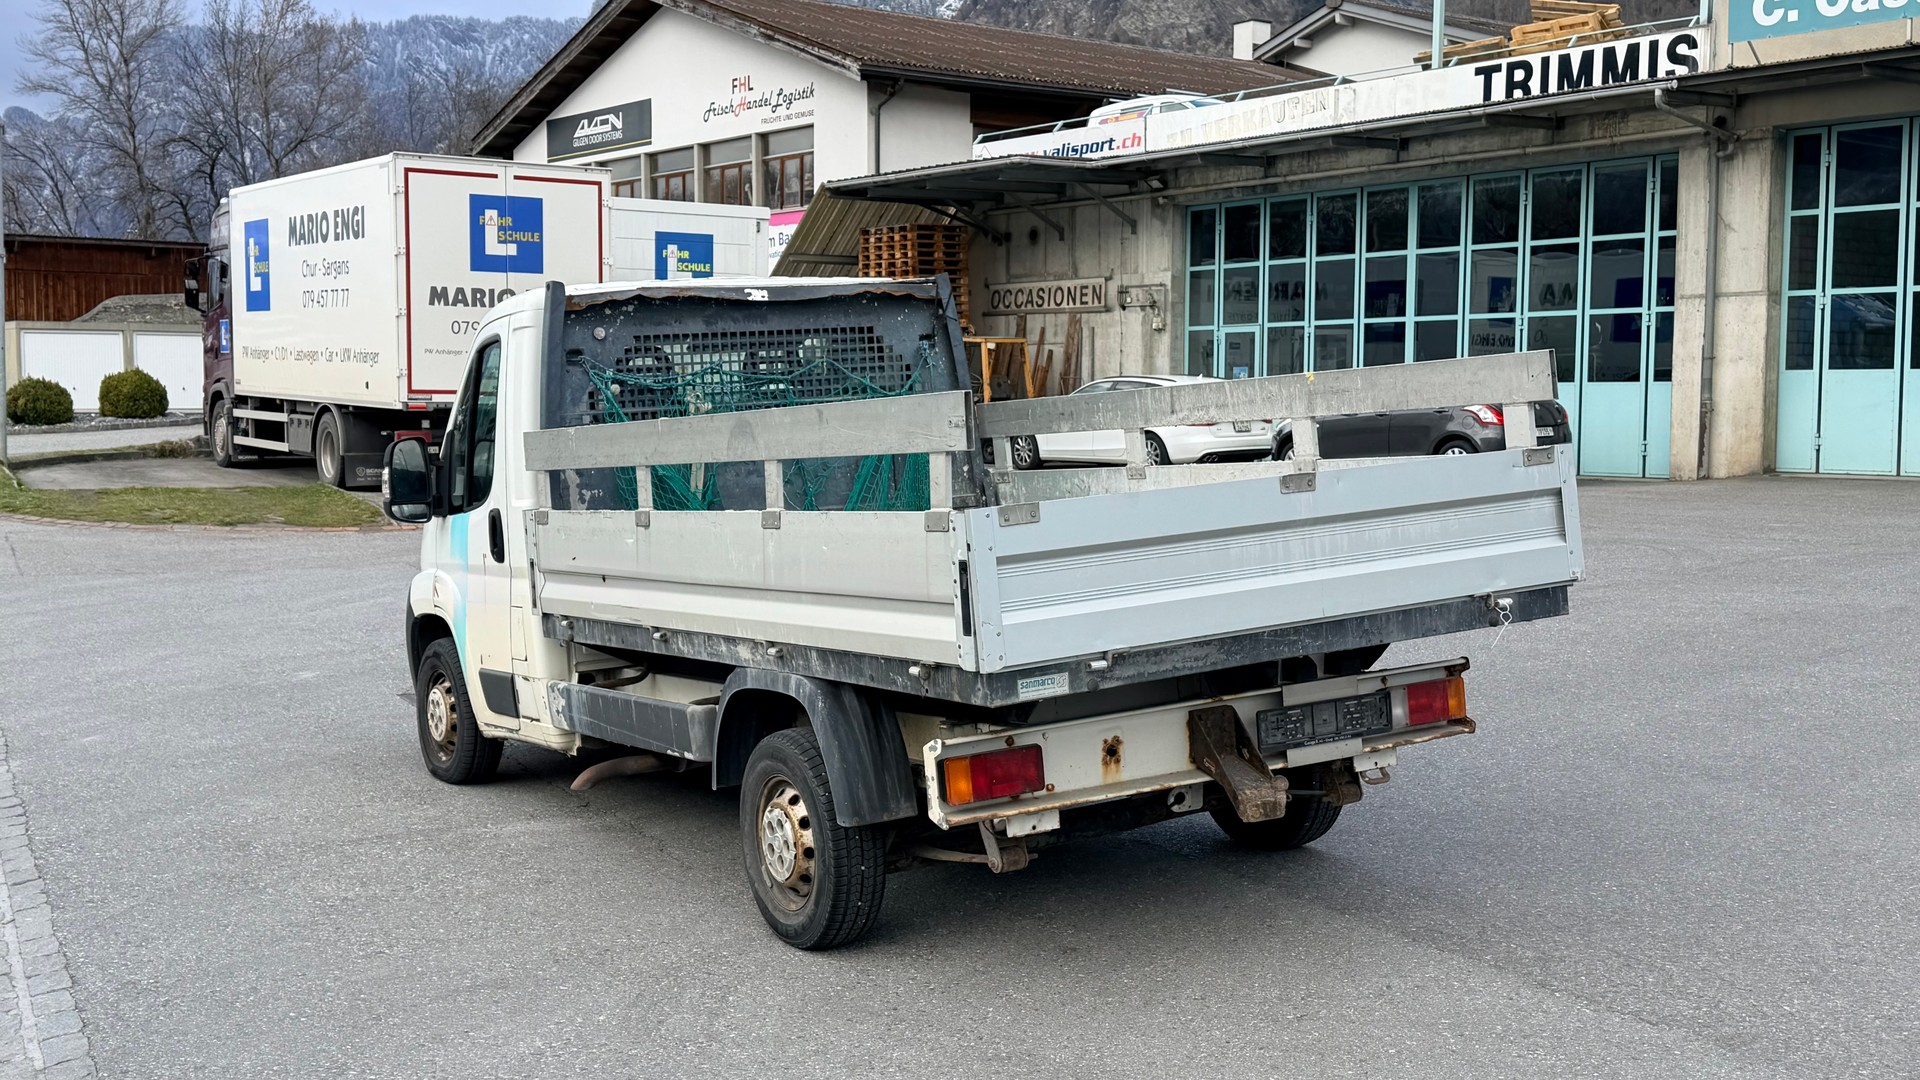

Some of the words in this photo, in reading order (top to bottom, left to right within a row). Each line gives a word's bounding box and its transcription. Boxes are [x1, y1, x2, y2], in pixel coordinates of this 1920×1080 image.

[1474, 33, 1699, 102] TRIMMIS
[731, 75, 754, 95] FHL
[782, 113, 793, 121] UND
[572, 136, 589, 148] GILGEN
[589, 134, 602, 145] DOOR
[602, 130, 623, 142] SYSTEMS
[1025, 132, 1142, 158] valisport.ch
[288, 211, 329, 247] MARIO
[333, 205, 365, 242] ENGI
[498, 230, 540, 242] SCHULE
[779, 231, 791, 246] Ba
[301, 259, 317, 278] Chur
[322, 258, 350, 279] Sargans
[677, 262, 711, 272] SCHULE
[302, 290, 314, 308] 079
[316, 289, 328, 308] 457
[330, 289, 339, 307] 77
[341, 288, 349, 307] 77
[990, 284, 1102, 310] OCCASIONEN
[242, 346, 249, 359] PW
[293, 346, 319, 365] Lastwagen
[324, 347, 335, 362] Car
[339, 348, 352, 363] LKW
[352, 348, 380, 367] Anhänger
[435, 348, 463, 357] Anhänger
[1020, 677, 1055, 689] sanmarco
